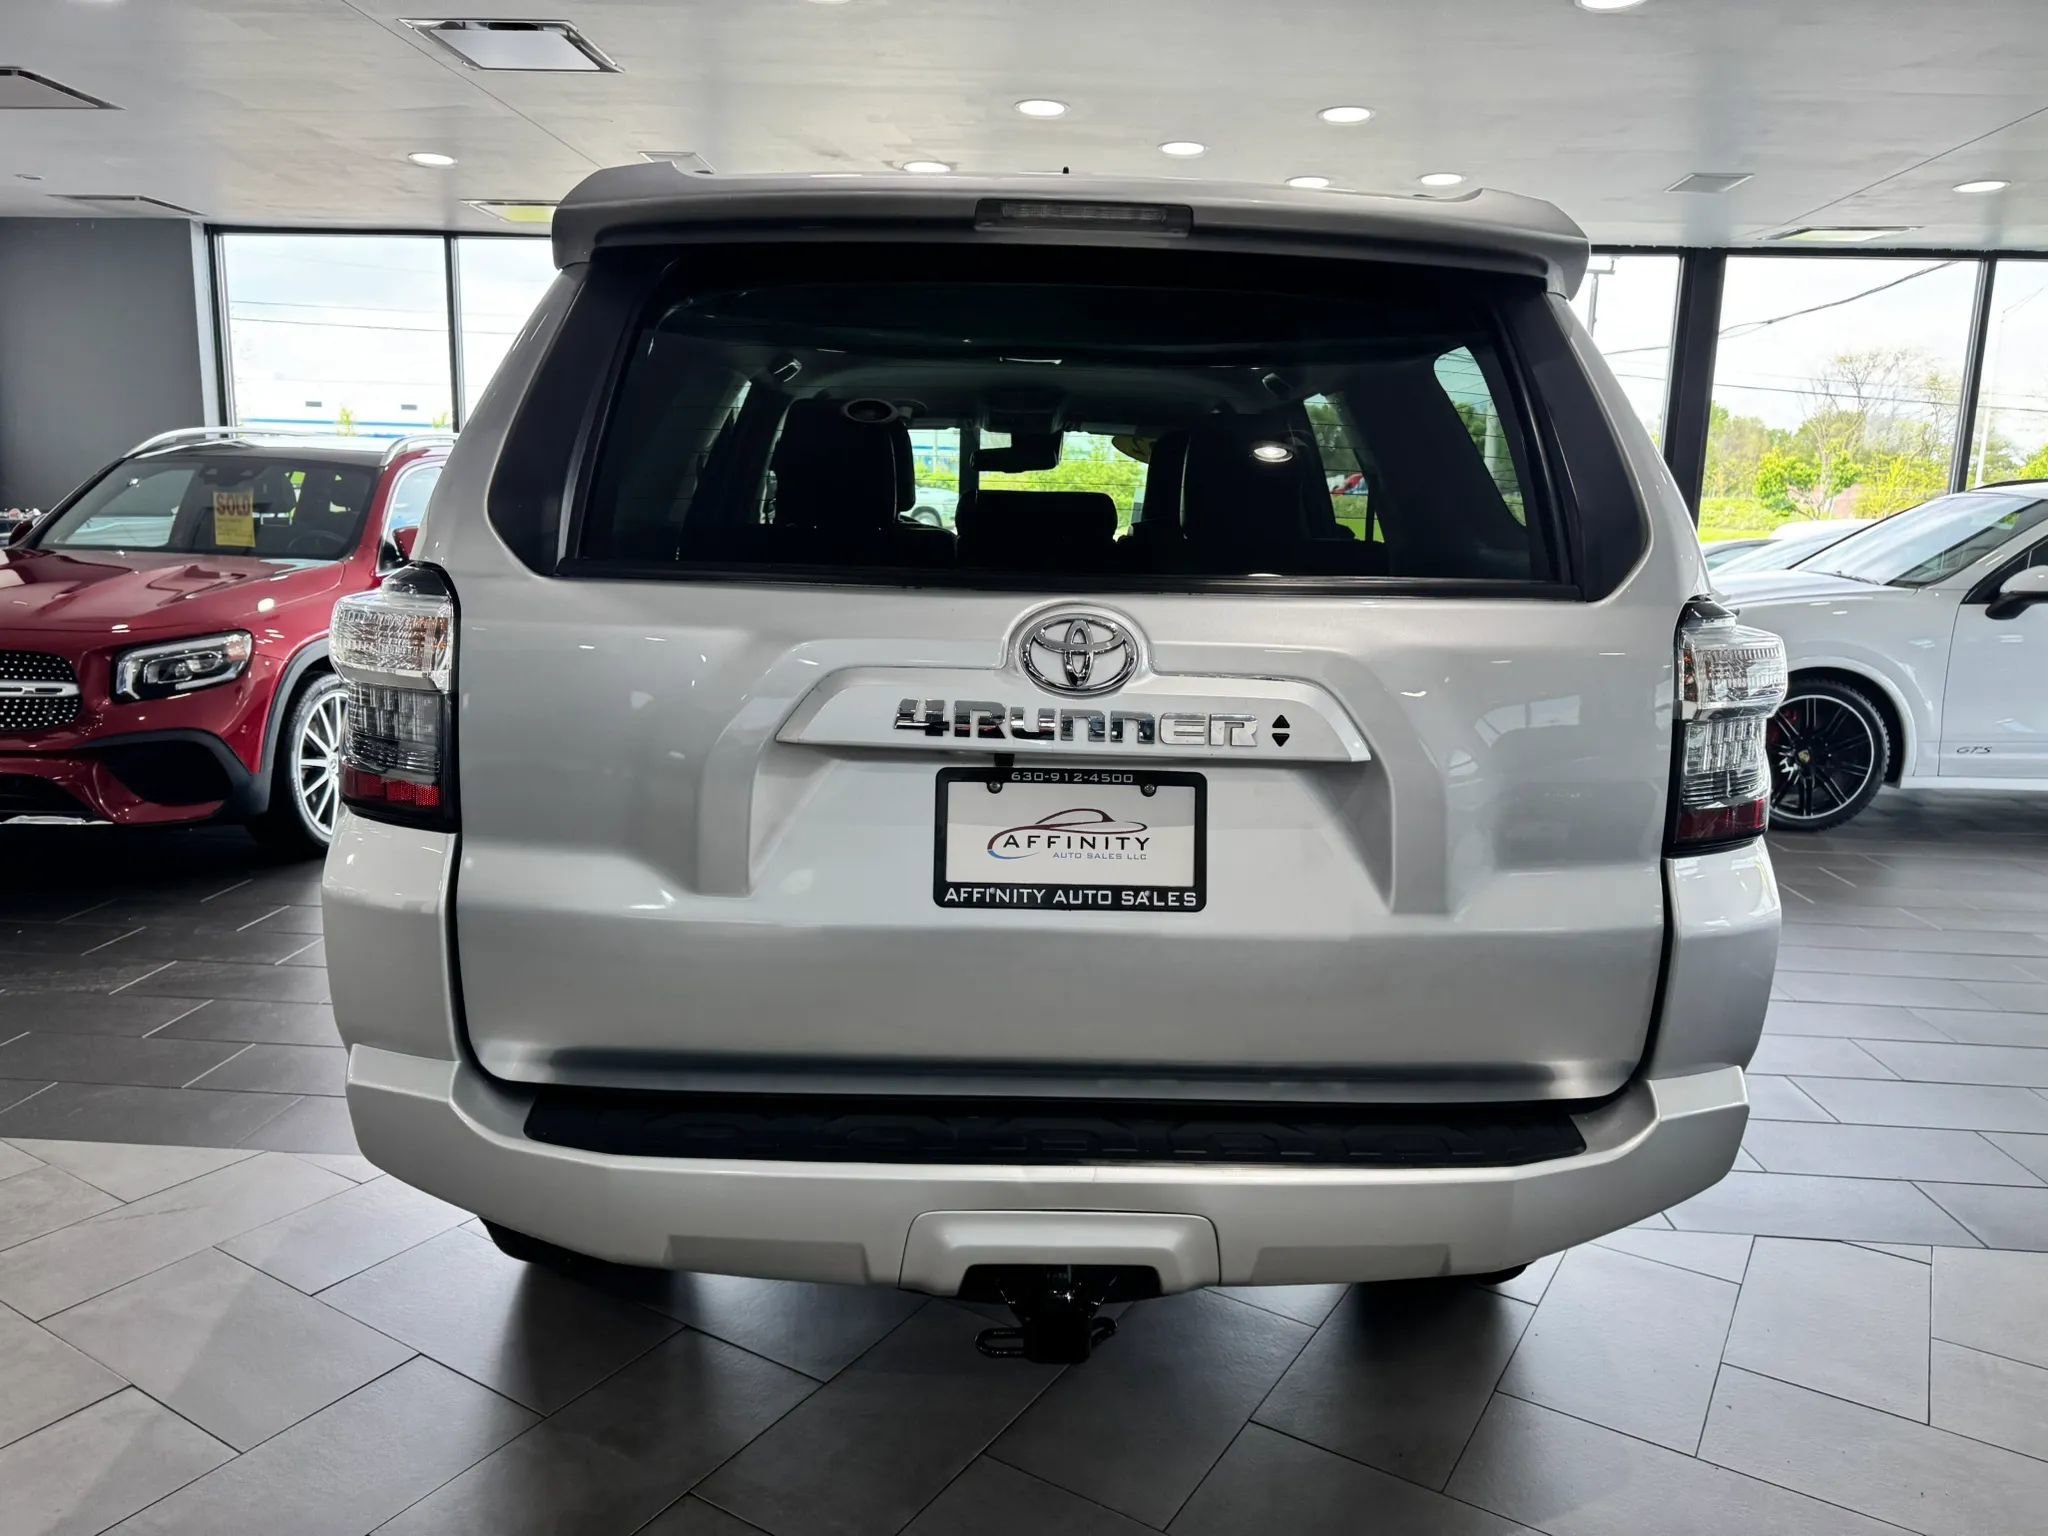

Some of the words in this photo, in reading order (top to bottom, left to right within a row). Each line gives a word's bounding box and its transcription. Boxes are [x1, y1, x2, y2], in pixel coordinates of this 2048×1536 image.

[216, 493, 251, 517] SOLD
[1956, 746, 1992, 754] GTS
[1011, 771, 1134, 783] 630-912-4500
[1003, 835, 1150, 851] AFFINITY
[1087, 852, 1122, 860] SALES
[944, 887, 1046, 904] AFFINITY
[1052, 889, 1112, 905] AUTO
[1121, 890, 1197, 907] SALES
